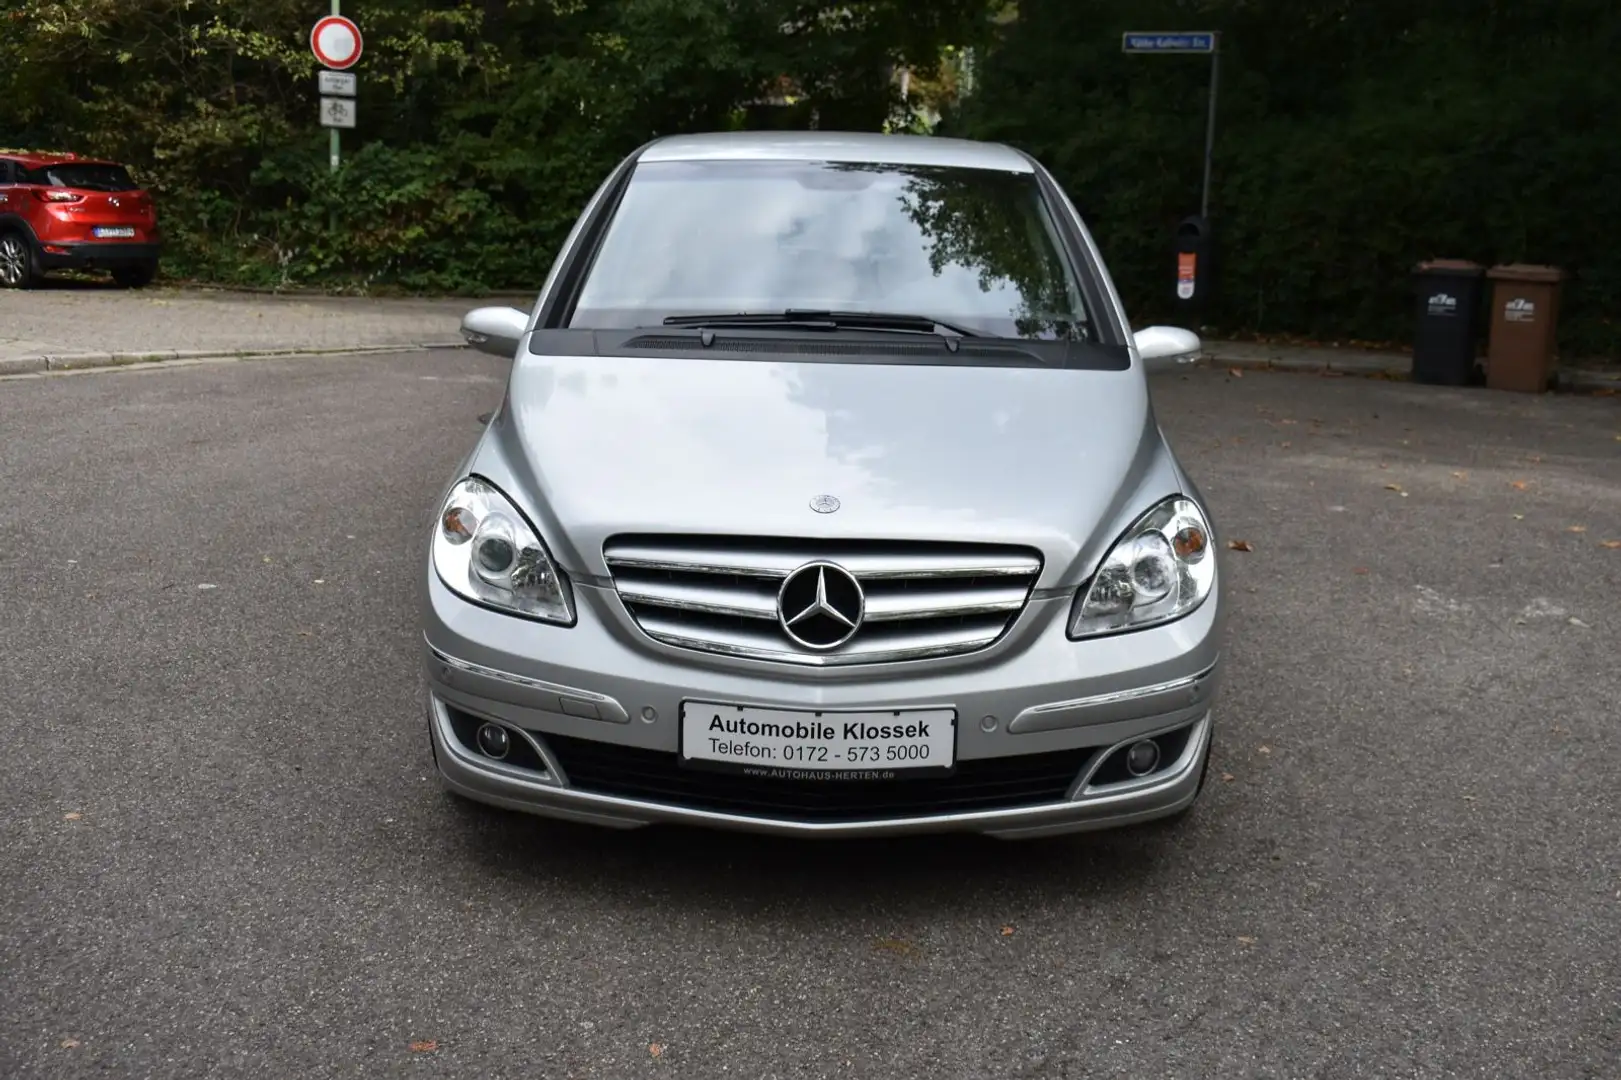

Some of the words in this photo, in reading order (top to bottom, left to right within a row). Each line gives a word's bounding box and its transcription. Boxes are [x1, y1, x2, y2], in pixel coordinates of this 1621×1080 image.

[708, 714, 836, 740] Automobile
[843, 720, 930, 740] Klossek
[708, 737, 777, 759] Telefon:
[783, 745, 828, 762] 0172
[847, 746, 880, 762] 573
[886, 744, 930, 761] 5000
[743, 767, 895, 781] www.AUTOHAUS-HERTEN.de
